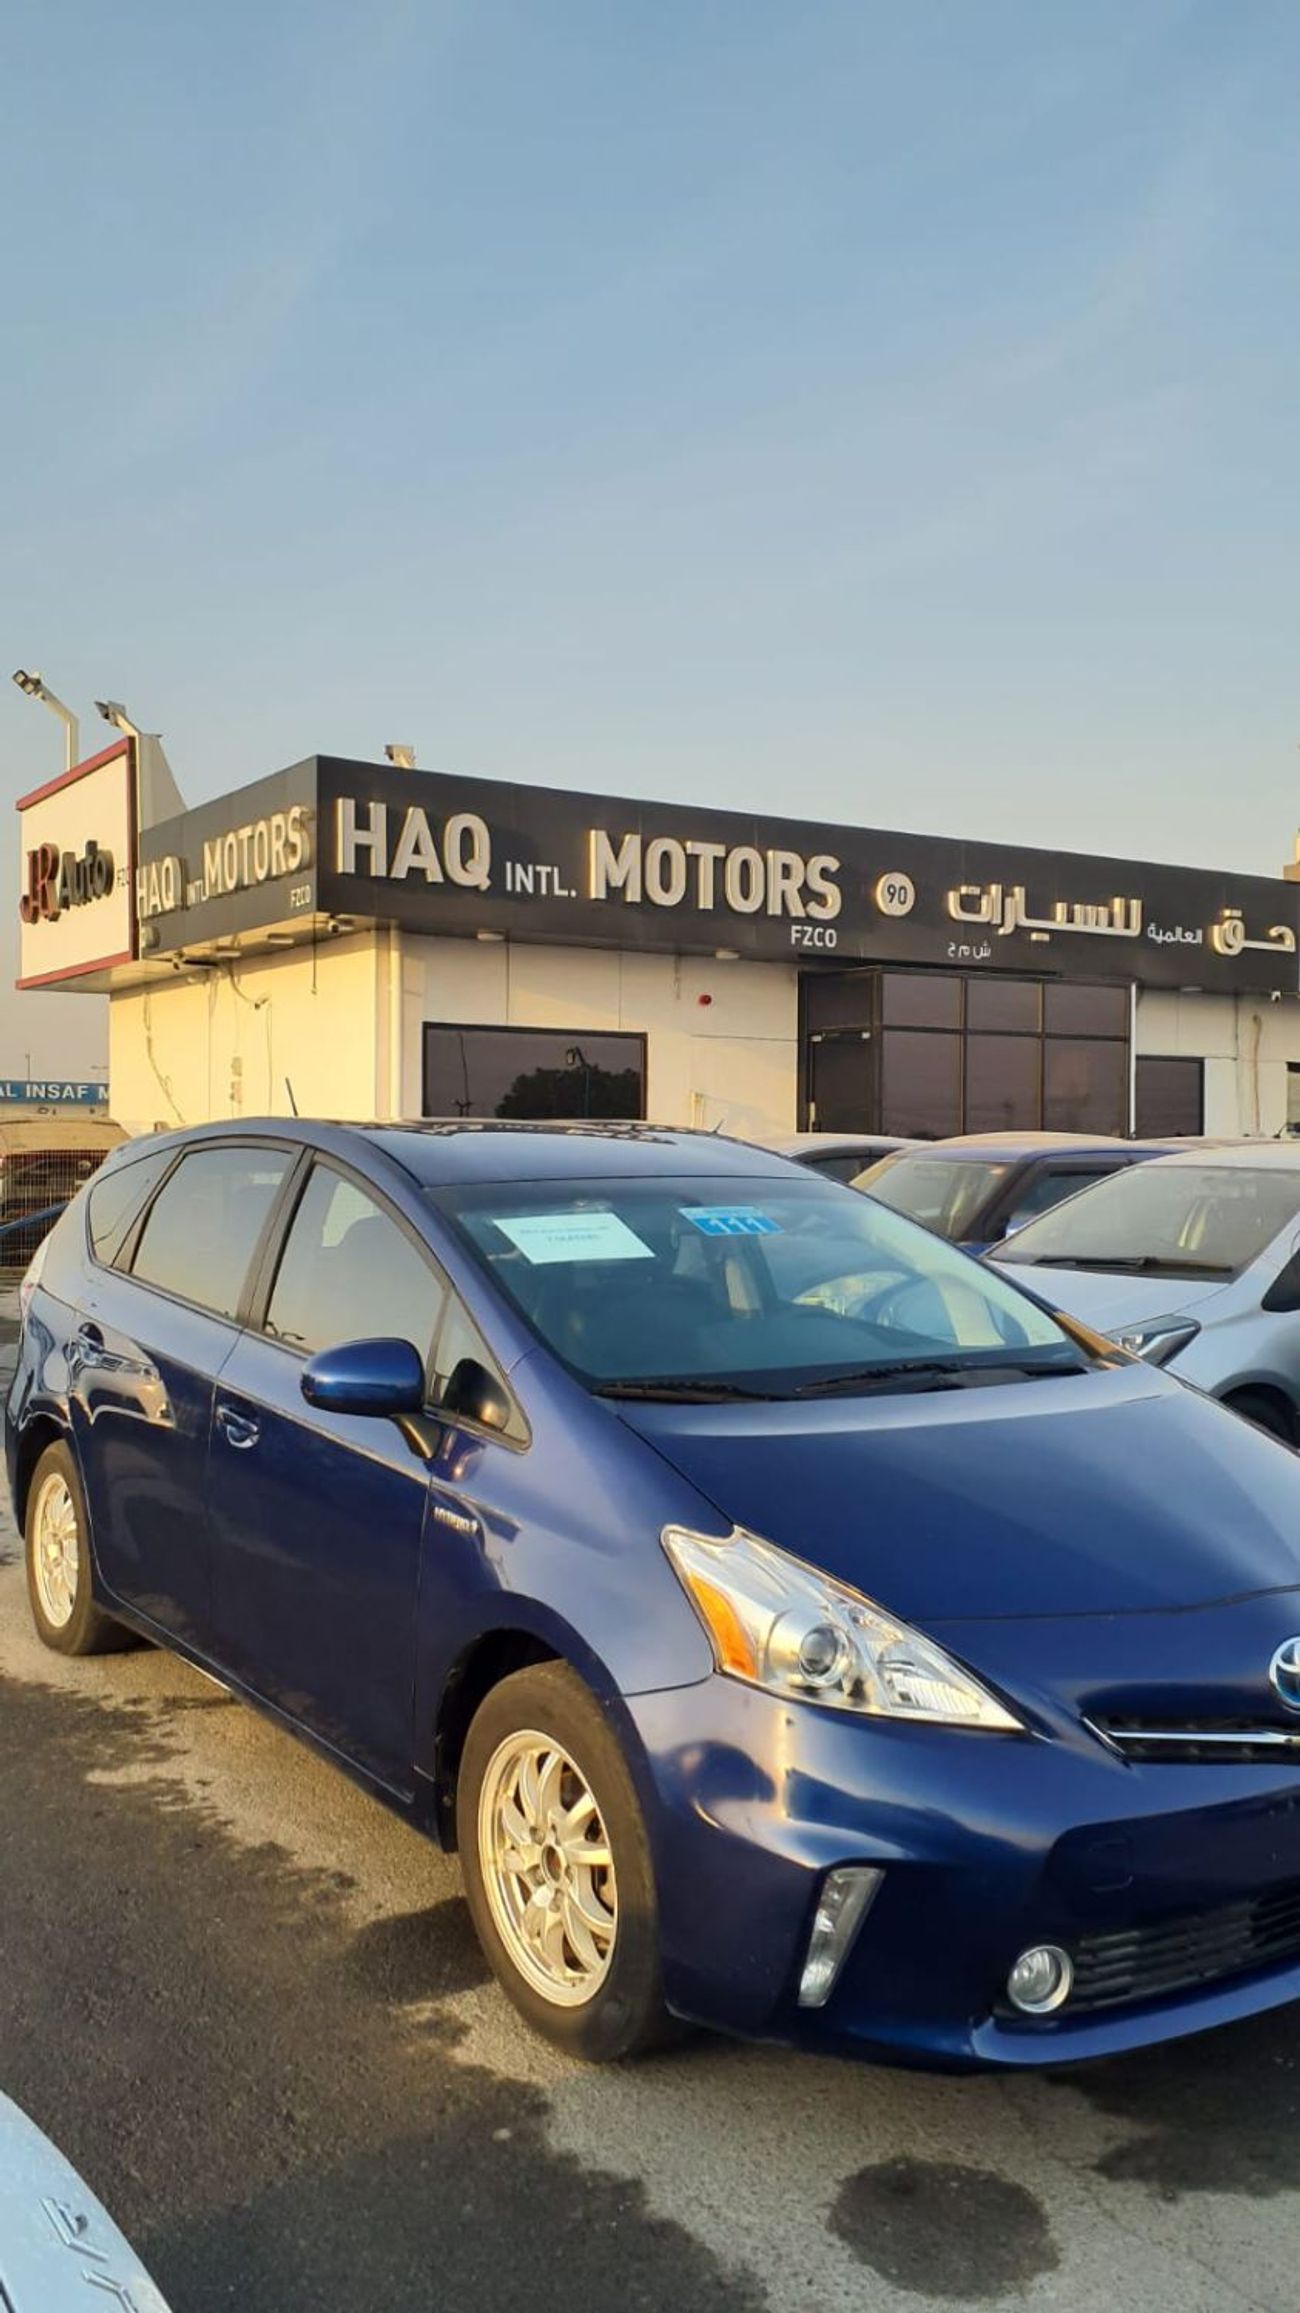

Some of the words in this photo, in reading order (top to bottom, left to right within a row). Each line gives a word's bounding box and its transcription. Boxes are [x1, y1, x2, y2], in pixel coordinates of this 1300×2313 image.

[136, 856, 182, 919] HAQ
[204, 805, 311, 895] MOTORS
[336, 797, 493, 891] HAQ
[505, 862, 577, 898] INTL.
[589, 829, 842, 920] MOTORS
[887, 883, 908, 906] 90
[948, 884, 1142, 942] للسيارات
[790, 925, 838, 948] FZCO
[1147, 922, 1203, 945] العالمية
[1212, 909, 1296, 956] حق
[26, 1084, 89, 1099] INSAF
[709, 1217, 769, 1235] 111
